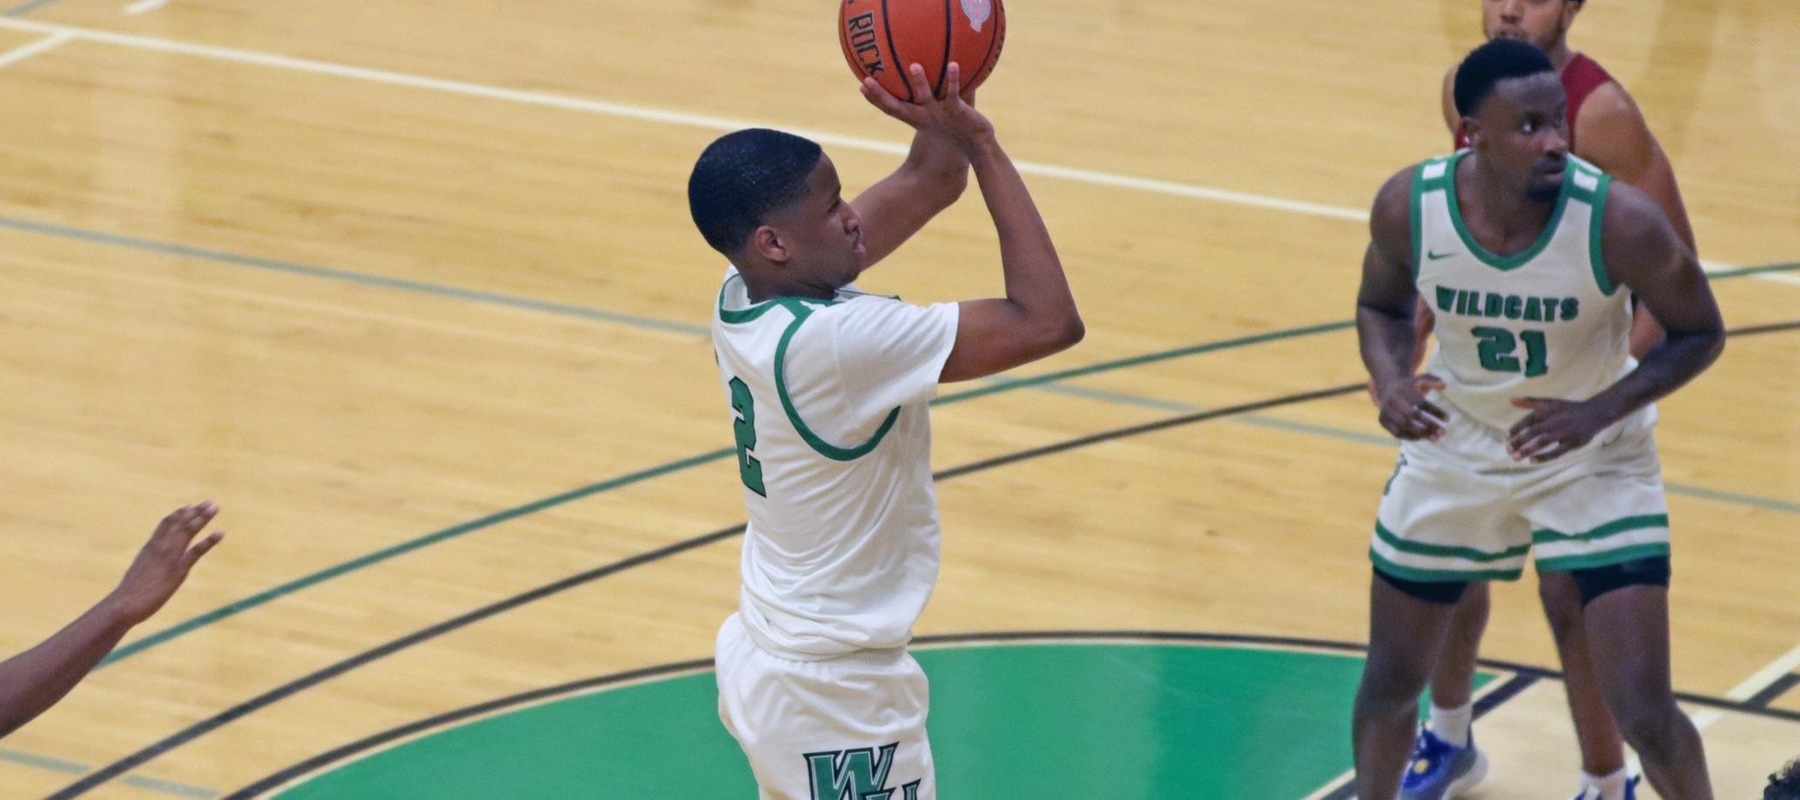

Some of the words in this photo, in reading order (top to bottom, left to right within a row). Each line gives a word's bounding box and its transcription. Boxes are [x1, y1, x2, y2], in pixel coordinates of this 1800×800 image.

[848, 12, 884, 76] ROCK
[1436, 285, 1579, 322] WILDCATS
[1471, 326, 1548, 378] 21
[728, 375, 767, 498] 2
